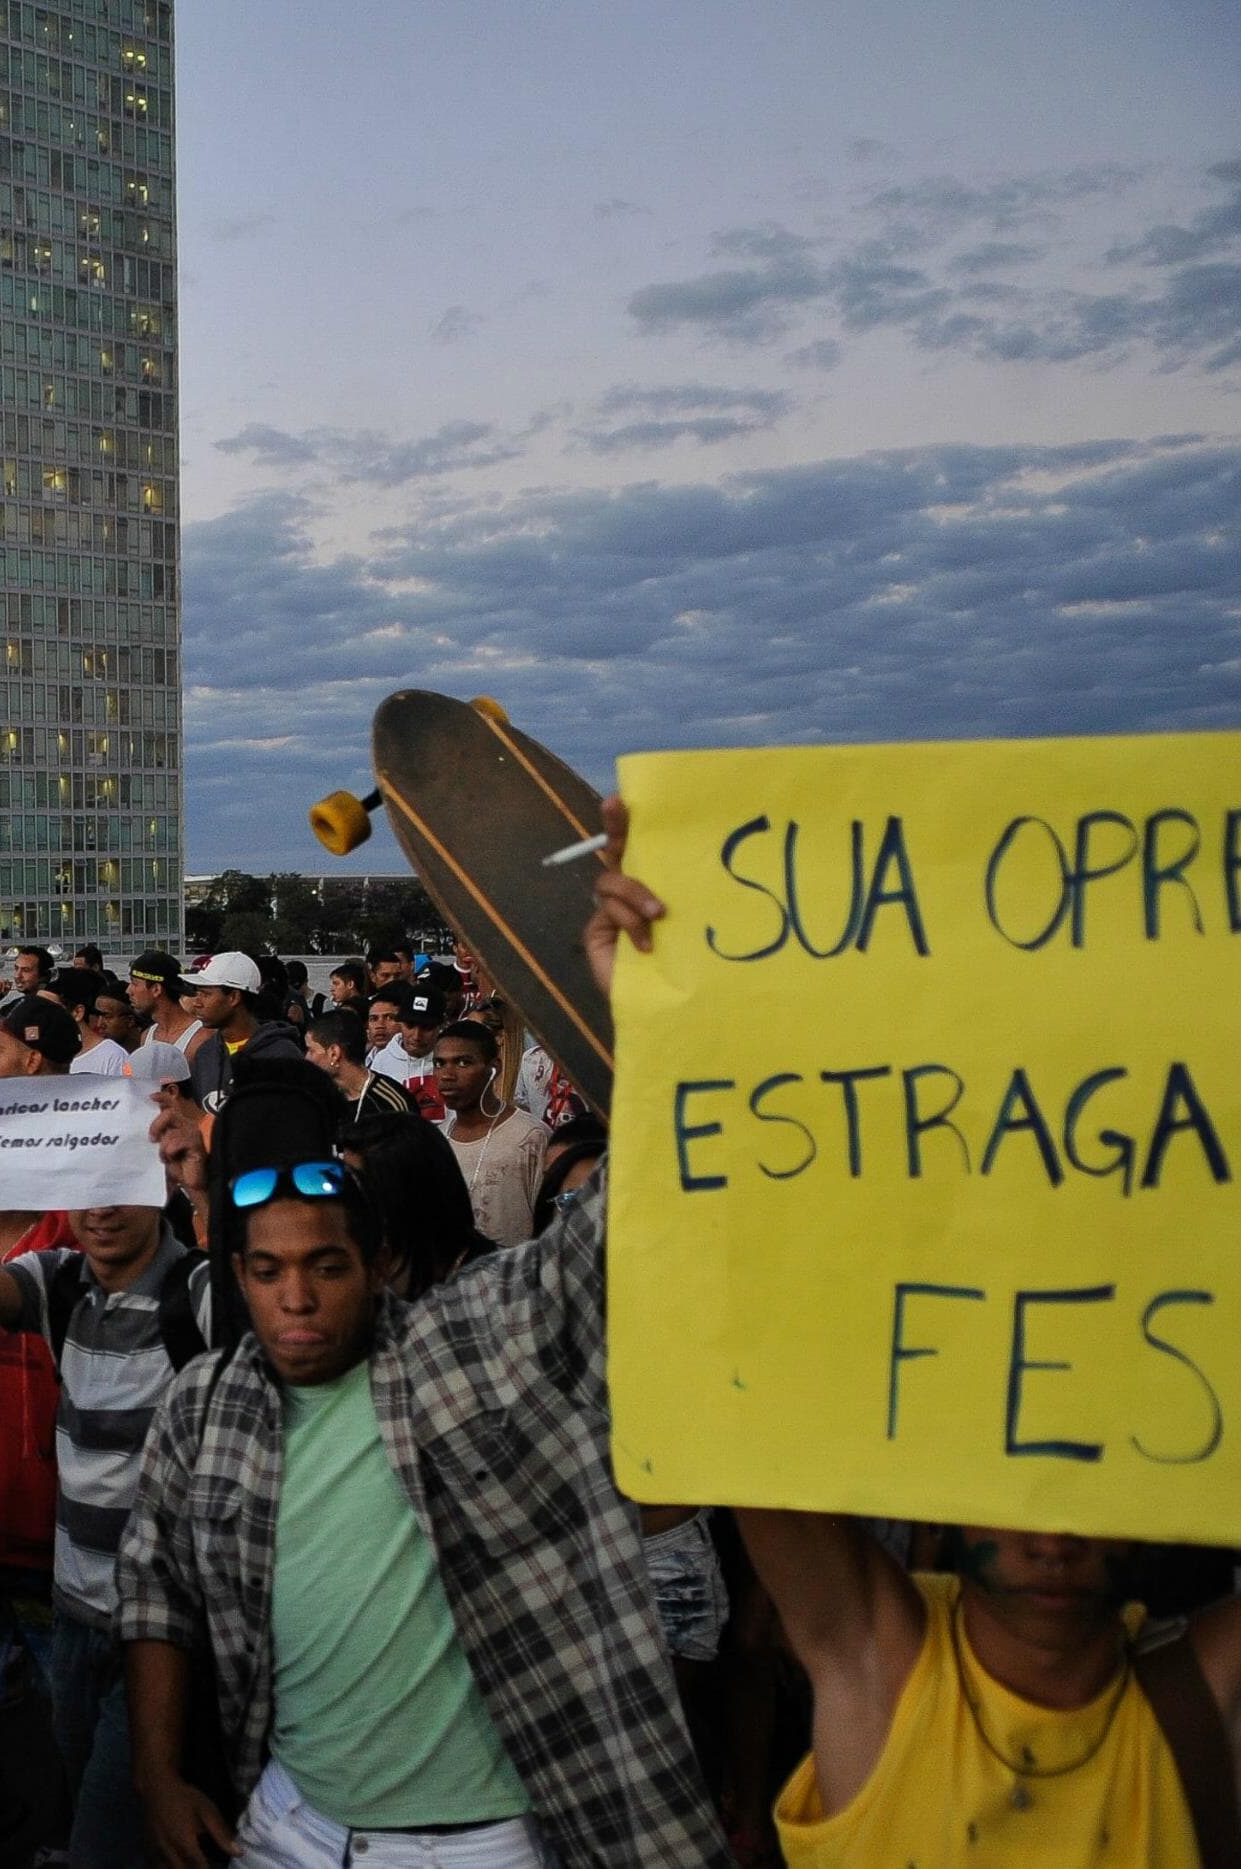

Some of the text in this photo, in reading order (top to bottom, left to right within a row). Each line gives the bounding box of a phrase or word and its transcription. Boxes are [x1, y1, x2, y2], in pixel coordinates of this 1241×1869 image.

[706, 815, 930, 961] SUA
[674, 1062, 1232, 1197] ESTRAGA
[887, 1282, 1223, 1464] FES
